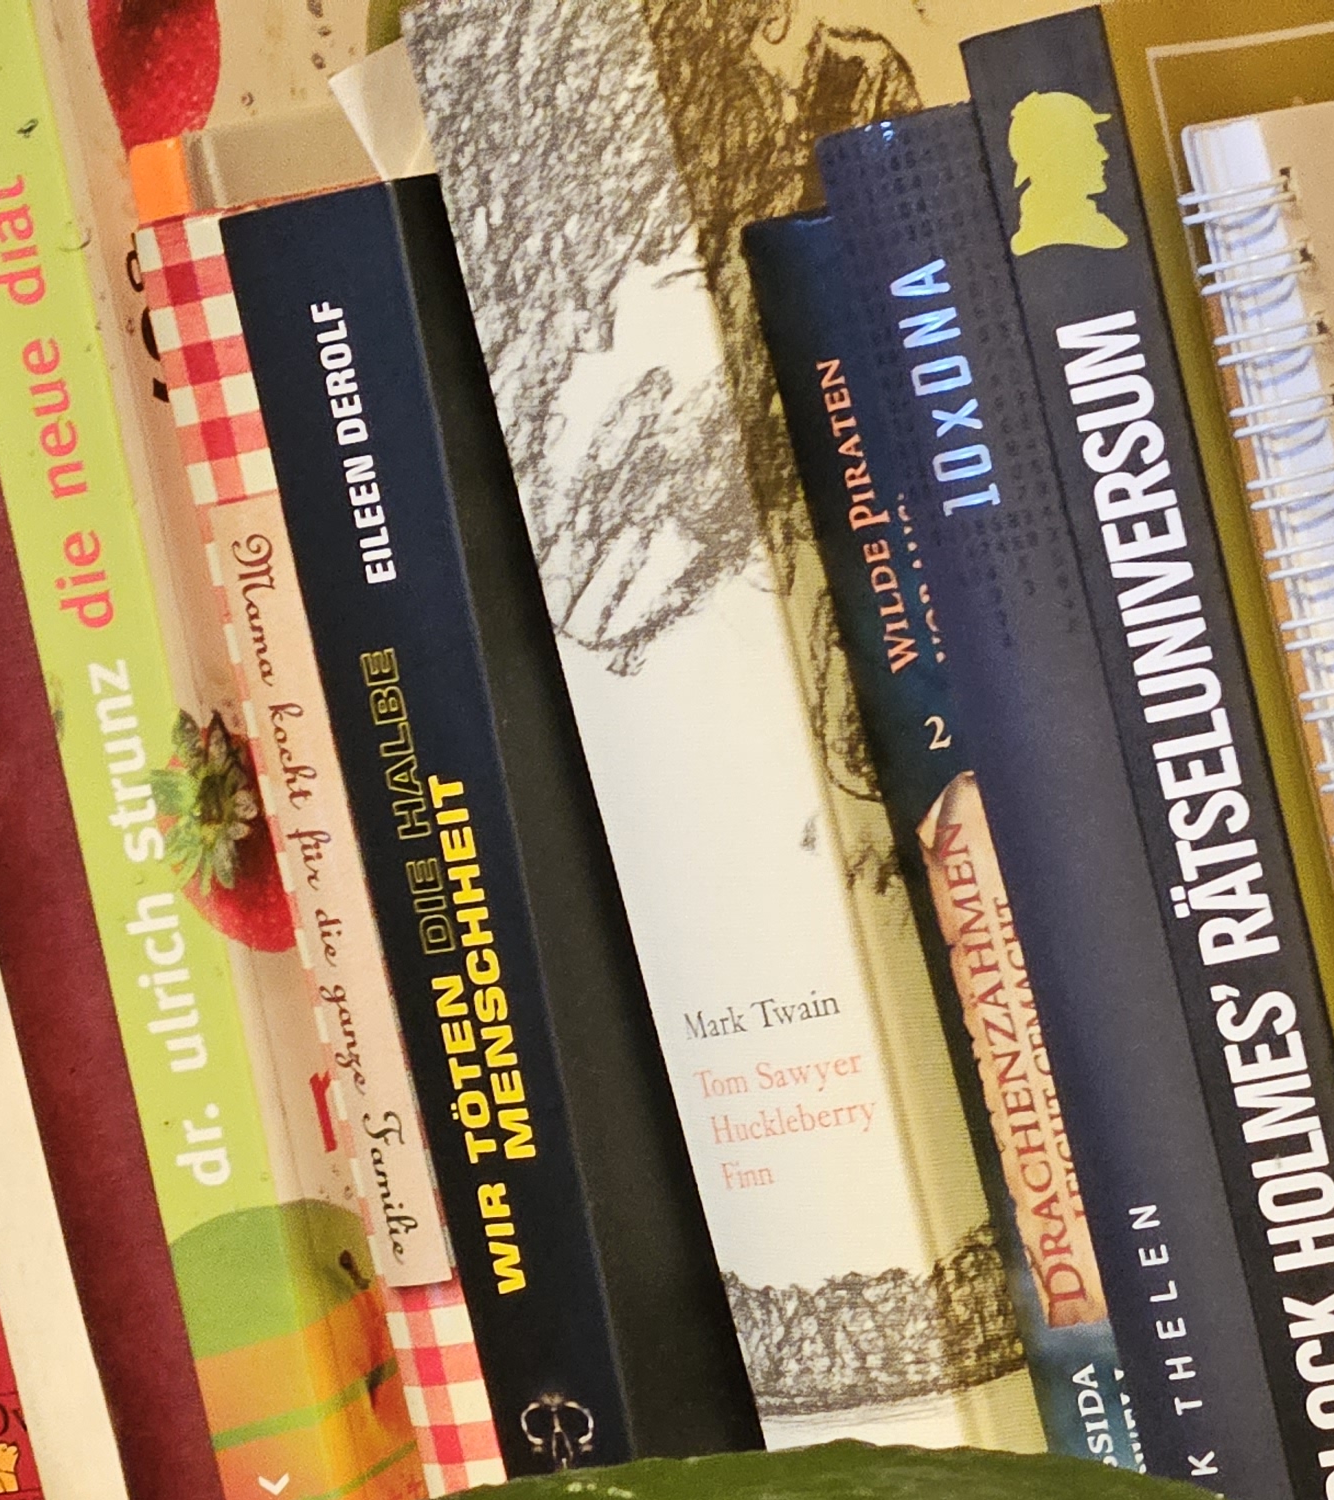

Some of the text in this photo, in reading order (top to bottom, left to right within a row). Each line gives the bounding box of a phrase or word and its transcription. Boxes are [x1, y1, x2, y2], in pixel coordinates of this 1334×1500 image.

[21, 334, 89, 501] neue
[310, 300, 397, 585] EILEEN DEROLF
[59, 529, 114, 630] die
[815, 357, 920, 674] WILDE PIRATEN
[922, 715, 953, 751] 2
[1055, 309, 1281, 967] RÄTSELUNIVERSUM
[87, 658, 165, 864] strunz
[126, 891, 208, 1074] ulrich
[230, 534, 420, 1267] Mama kocht für die ganze Familie
[359, 647, 528, 1295] WIR TÖTEN DIE HALBE
[427, 775, 537, 1160] MENSCHHEIT
[682, 990, 842, 1041] Mark Twain
[693, 1054, 862, 1100] Tom Sawyer
[934, 822, 1089, 1327] DRACHENZÄHMEN
[176, 1099, 233, 1187] dr.
[709, 1101, 878, 1146] Huckleberry
[720, 1160, 776, 1191] Finn
[1128, 1204, 1204, 1416] THELEN
